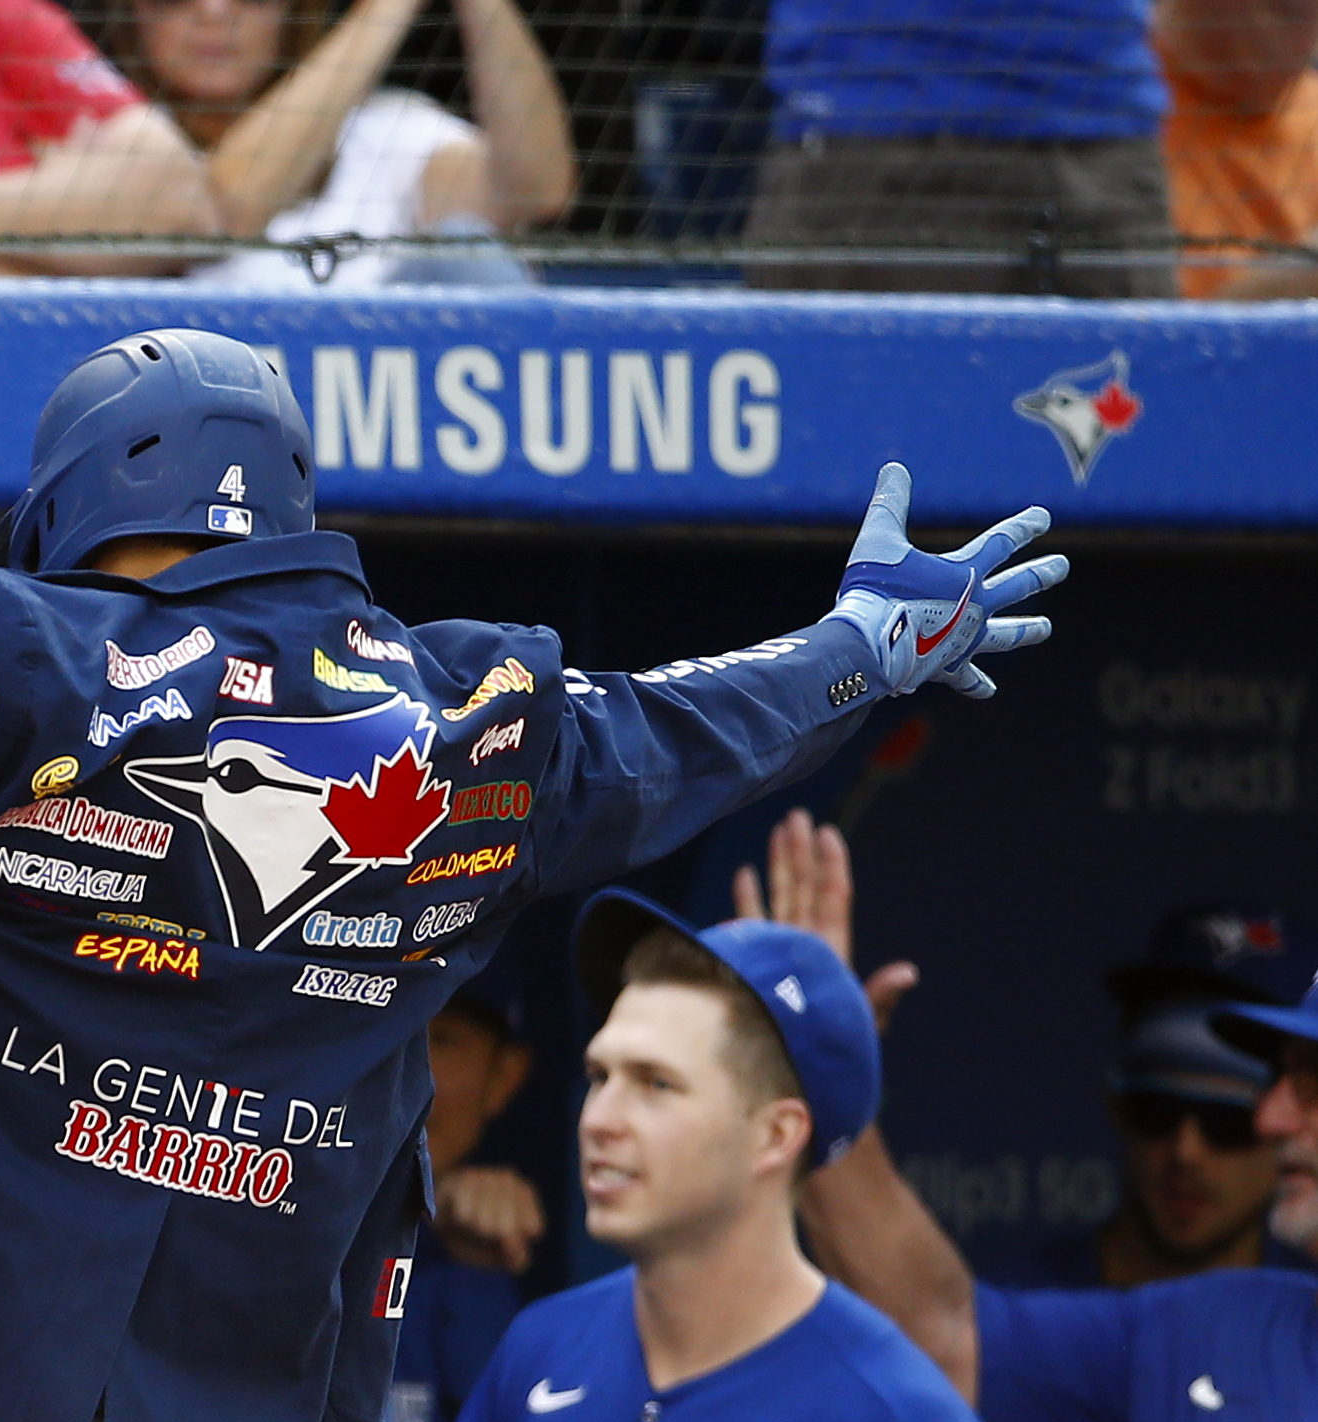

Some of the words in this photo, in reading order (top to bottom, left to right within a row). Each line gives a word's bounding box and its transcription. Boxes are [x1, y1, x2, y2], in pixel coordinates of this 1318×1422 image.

[217, 464, 246, 503] 4
[158, 625, 216, 673] RICO
[313, 647, 399, 693] BRASIL
[218, 655, 275, 706] USA
[447, 780, 533, 828] MEXICO
[63, 797, 174, 860] DOMINICANA
[405, 844, 518, 885] COLOMBIA
[303, 910, 403, 948] Grecia
[413, 896, 485, 942] CUBA
[74, 933, 202, 980] ESPAÑA
[292, 964, 398, 1008] ISRAEL
[0, 1025, 67, 1087] LA
[92, 1057, 266, 1138] GENTE
[282, 1099, 355, 1149] DEL
[54, 1099, 294, 1208] BARRIO
